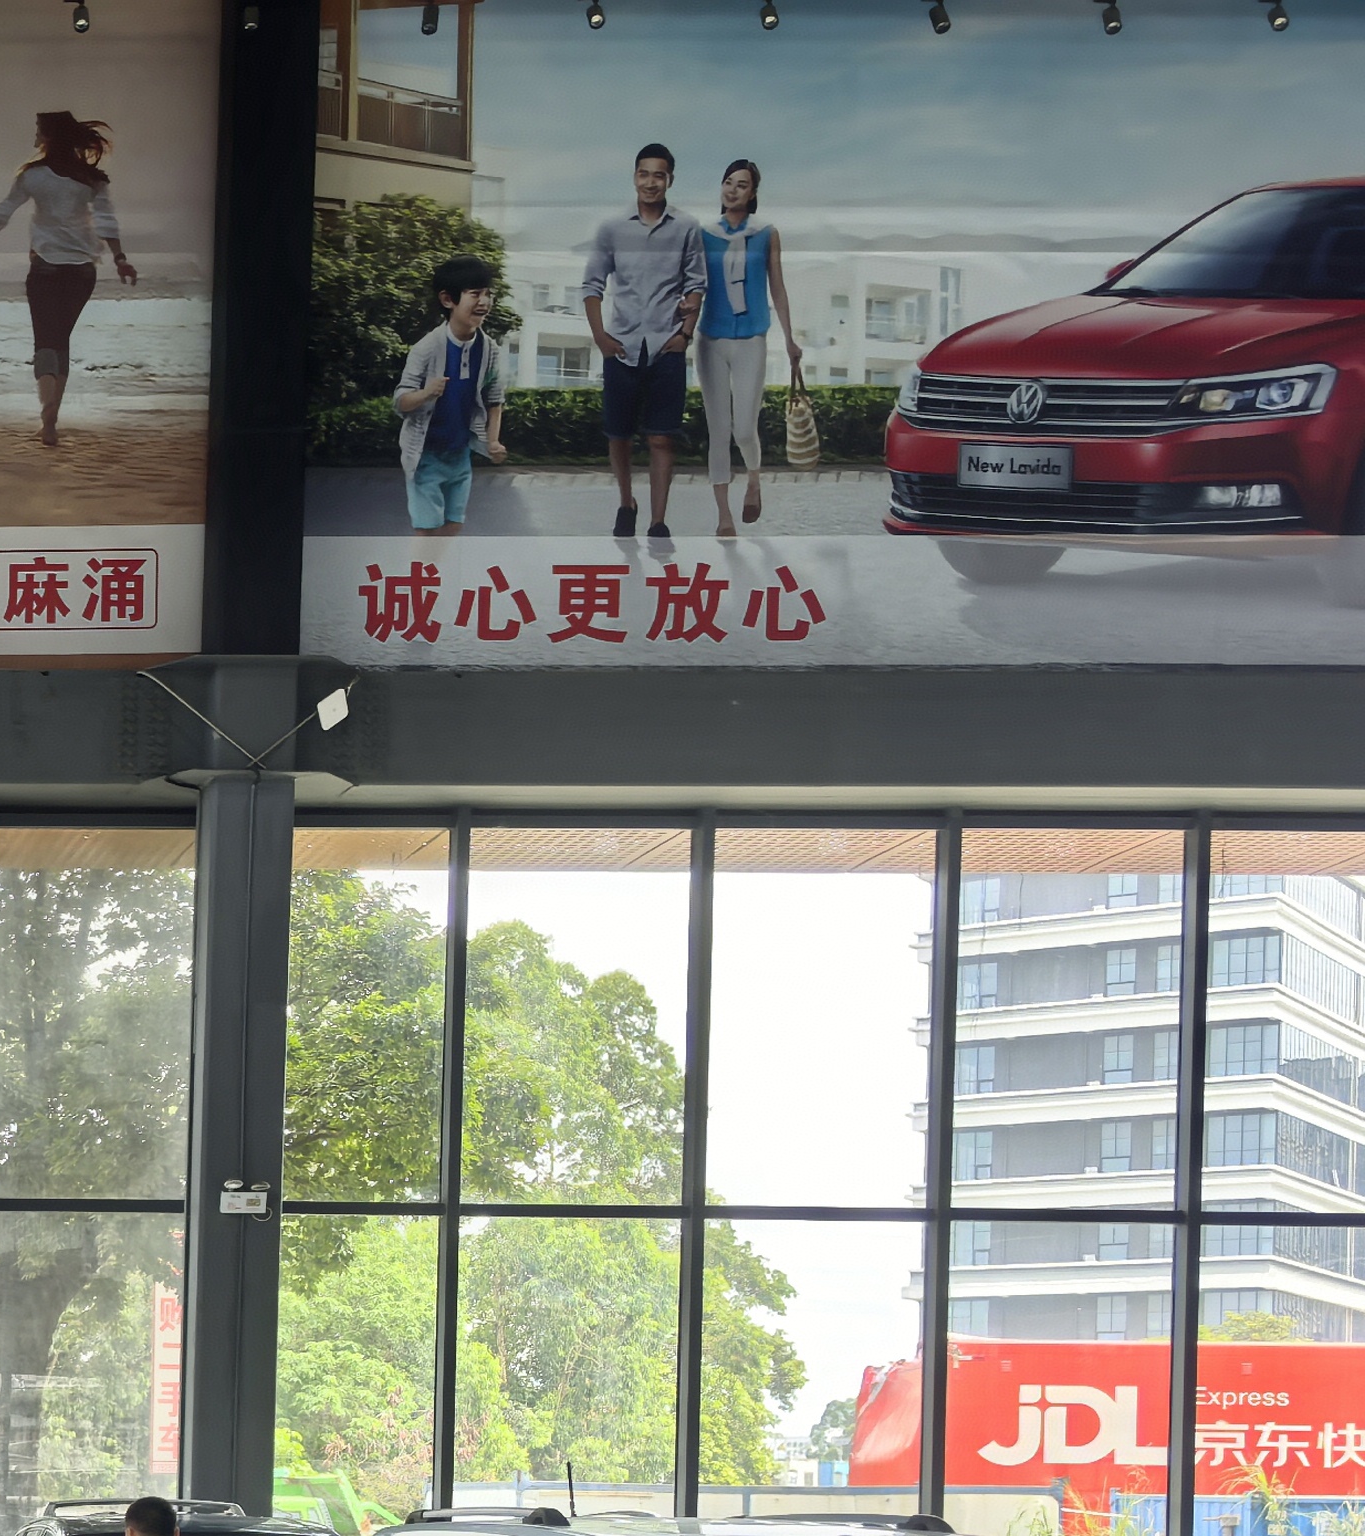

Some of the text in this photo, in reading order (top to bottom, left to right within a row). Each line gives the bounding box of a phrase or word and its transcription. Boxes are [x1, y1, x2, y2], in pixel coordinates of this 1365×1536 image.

[967, 456, 1062, 476] New Lavida
[3, 556, 145, 624] 麻涌
[359, 561, 826, 644] 诚心更放心
[977, 1384, 1290, 1466] JDL Express
